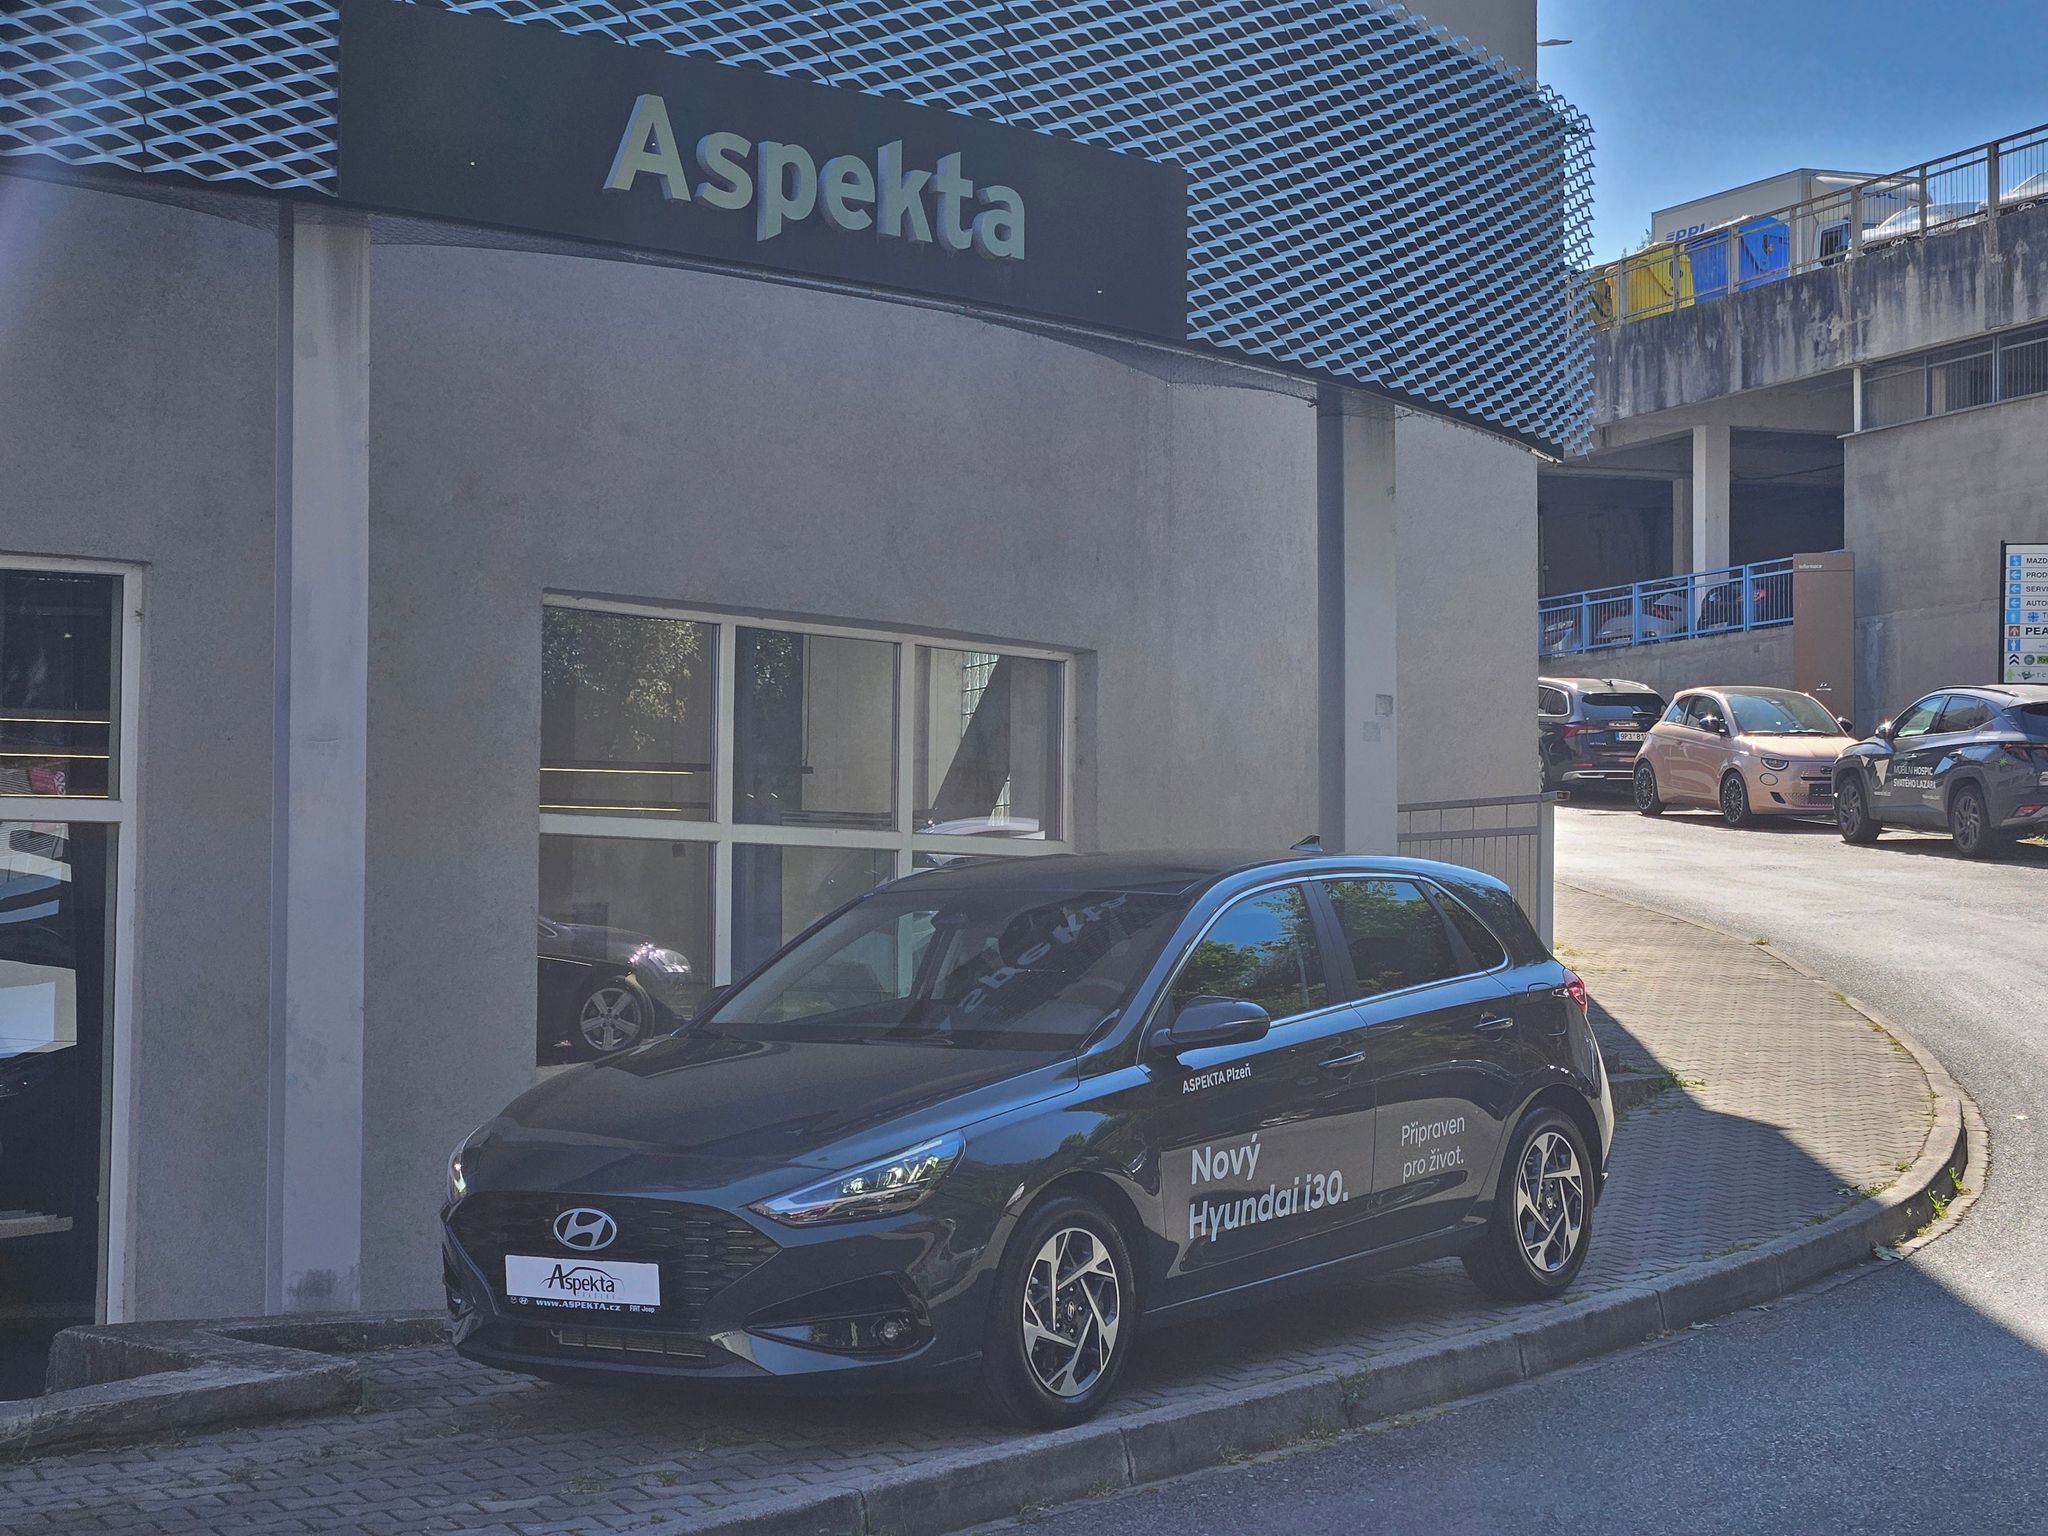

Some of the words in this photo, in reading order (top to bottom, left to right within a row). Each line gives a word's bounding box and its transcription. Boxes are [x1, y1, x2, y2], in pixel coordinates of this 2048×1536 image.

[603, 93, 1026, 261] Aspekta
[1893, 777, 1916, 788] SVATÉHO
[1913, 766, 1934, 776] HOSPIC
[1182, 1069, 1226, 1094] ASPEKTA
[1226, 1063, 1251, 1083] Plzeň
[1401, 1116, 1465, 1147] Připraven
[1191, 1133, 1261, 1185] Nový
[1402, 1158, 1426, 1184] pro
[1428, 1145, 1464, 1172] život.
[1189, 1176, 1299, 1242] Hyundai
[1304, 1170, 1349, 1211] i30.
[548, 1264, 615, 1296] Aspekta
[535, 1299, 621, 1312] www.ASPEKTA.cz
